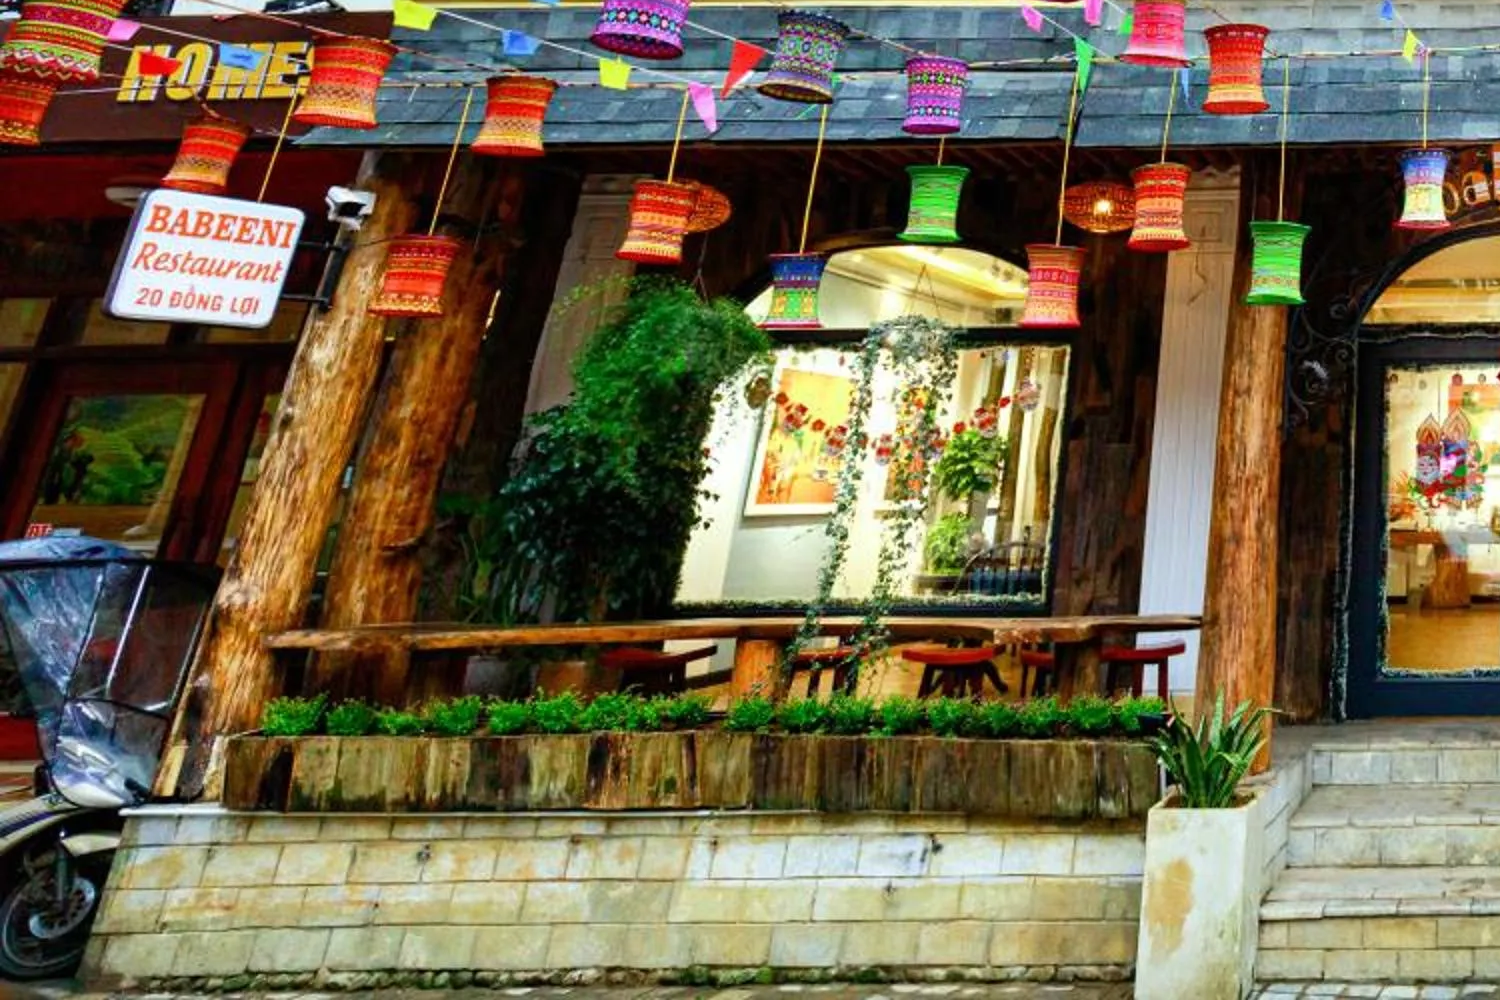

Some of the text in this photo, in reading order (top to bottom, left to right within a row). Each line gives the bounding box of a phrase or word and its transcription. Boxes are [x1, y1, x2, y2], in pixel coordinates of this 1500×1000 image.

[117, 41, 315, 102] HOME
[145, 204, 296, 249] BABEENI
[132, 241, 283, 284] Restaurant
[134, 287, 164, 306] 20
[229, 298, 260, 318] LỢI
